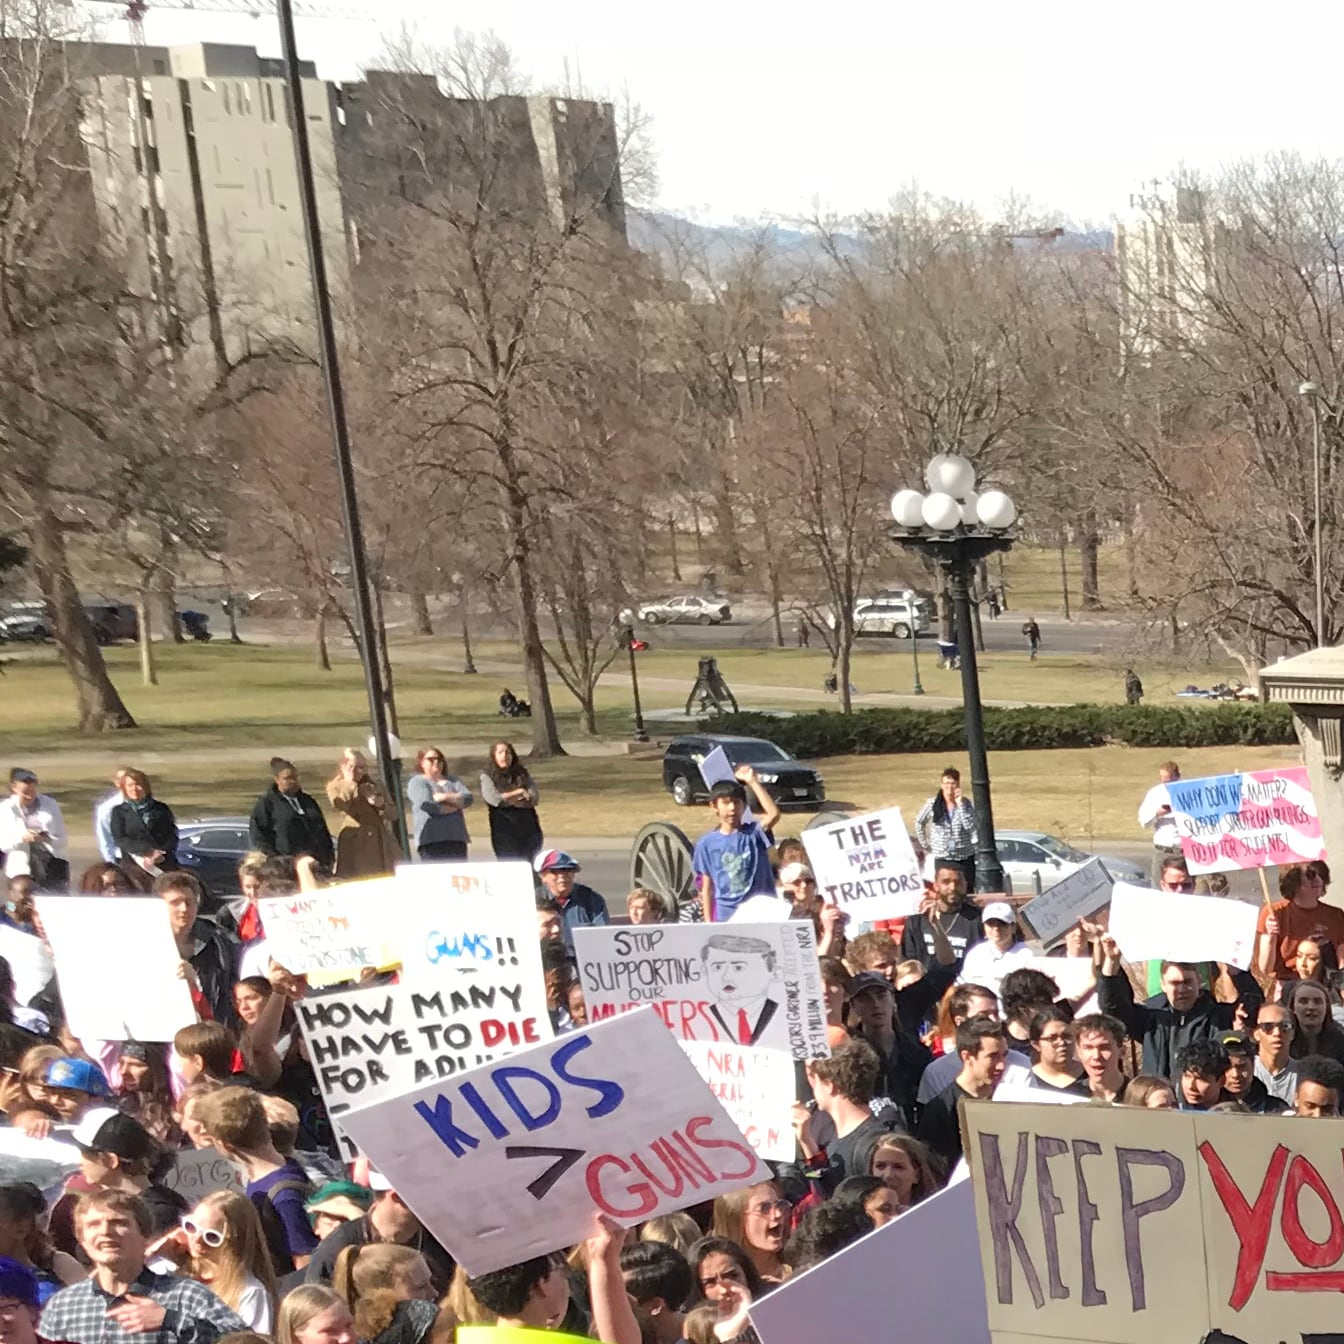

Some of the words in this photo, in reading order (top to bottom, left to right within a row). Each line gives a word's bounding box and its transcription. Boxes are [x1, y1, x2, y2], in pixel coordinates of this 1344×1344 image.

[1176, 789, 1204, 811] WHY
[1246, 779, 1287, 803] MATTER?
[828, 819, 886, 850] THE
[1184, 813, 1222, 838] SUPPORT
[1220, 838, 1237, 859] FOR
[1240, 832, 1289, 857] STUDENTS!
[859, 860, 885, 874] ARE
[824, 873, 921, 905] TRAITORS
[614, 930, 664, 956] STOP
[796, 925, 813, 949] NRA
[584, 957, 701, 992] SUPPORTING
[301, 994, 395, 1033] HOW
[411, 983, 523, 1020] MANY
[628, 985, 665, 1001] OUR
[310, 1028, 414, 1065] HAVE
[417, 1023, 473, 1052] TO
[479, 1016, 542, 1049] DIE
[319, 1058, 391, 1096] FOR
[707, 1047, 746, 1079] NRA
[413, 1033, 626, 1159] KIDS
[584, 1115, 757, 1219] GUNS
[978, 1131, 1187, 1312] KEEP
